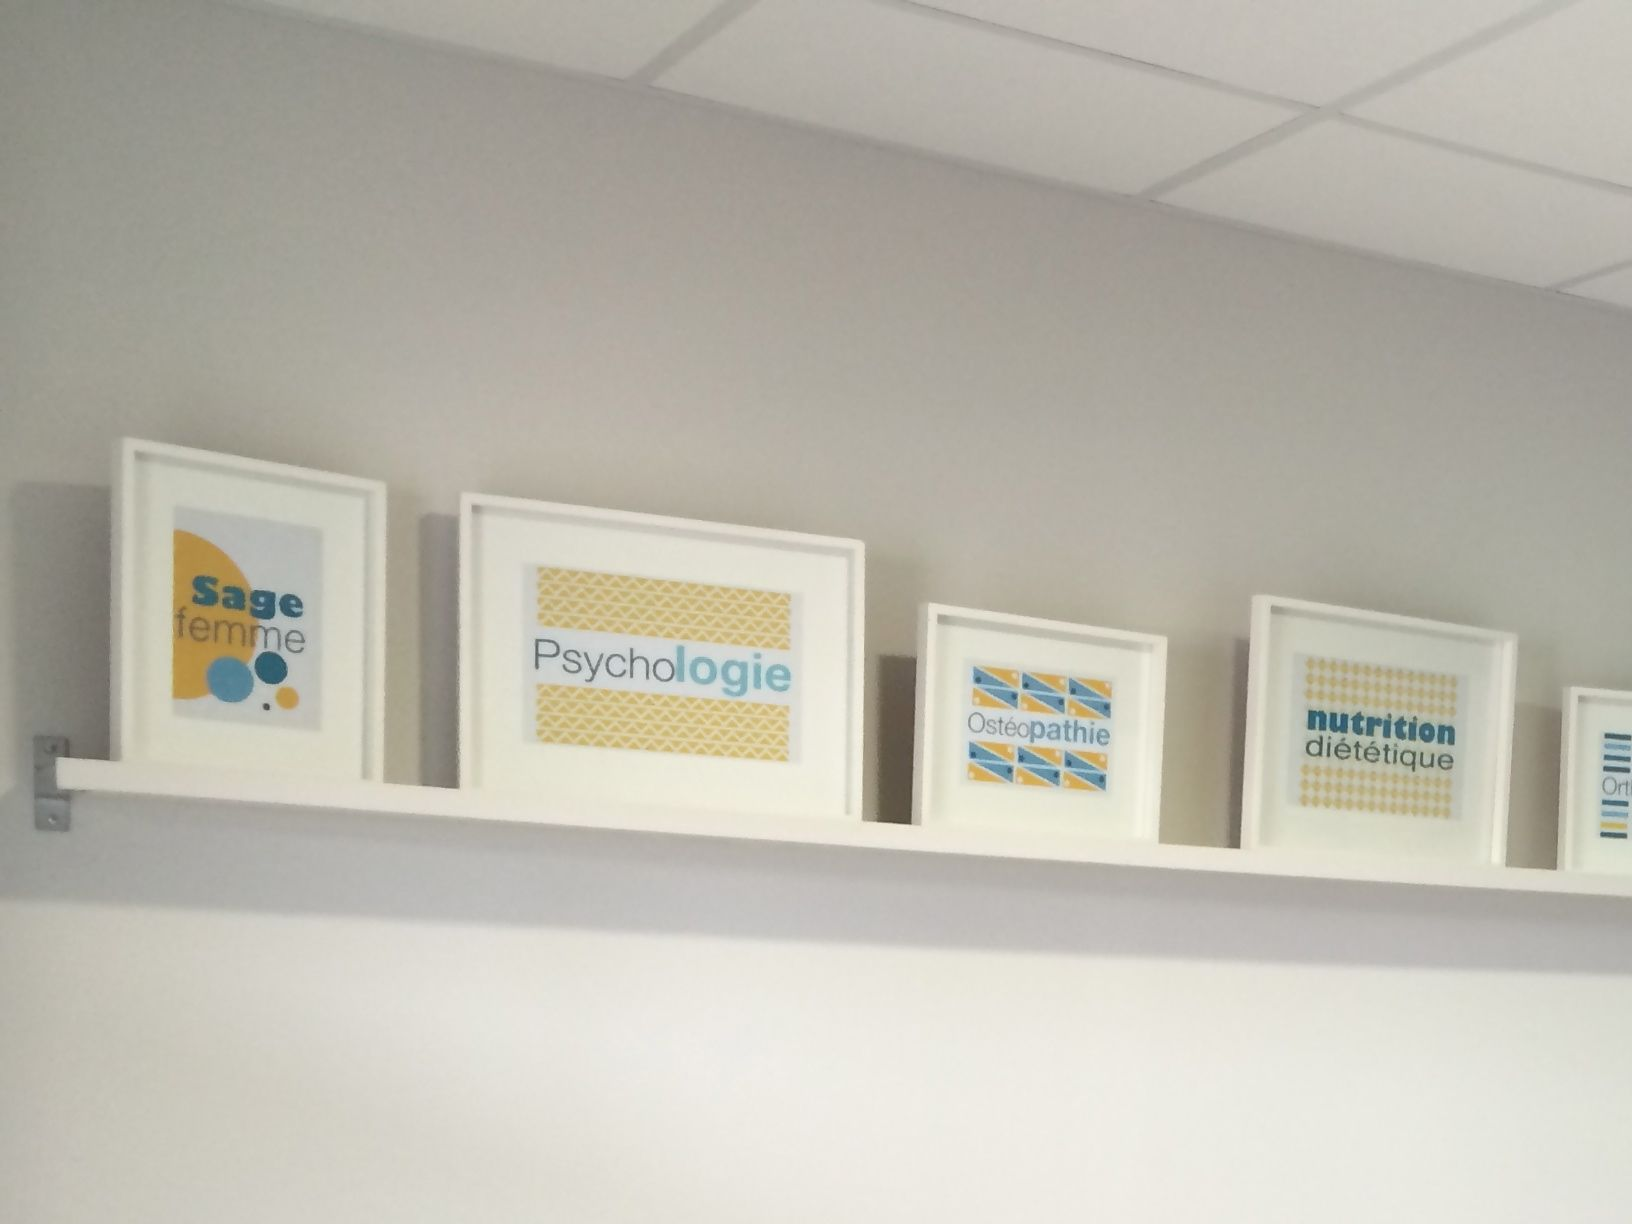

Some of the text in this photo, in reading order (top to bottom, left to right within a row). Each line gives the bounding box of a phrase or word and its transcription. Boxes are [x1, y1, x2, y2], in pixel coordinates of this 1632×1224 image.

[192, 575, 304, 620] Sage
[175, 606, 305, 654] femme
[534, 638, 792, 697] Psychologie
[967, 712, 1111, 746] Ostéopathie
[1307, 709, 1456, 746] nutrition
[1305, 735, 1455, 772] diététique
